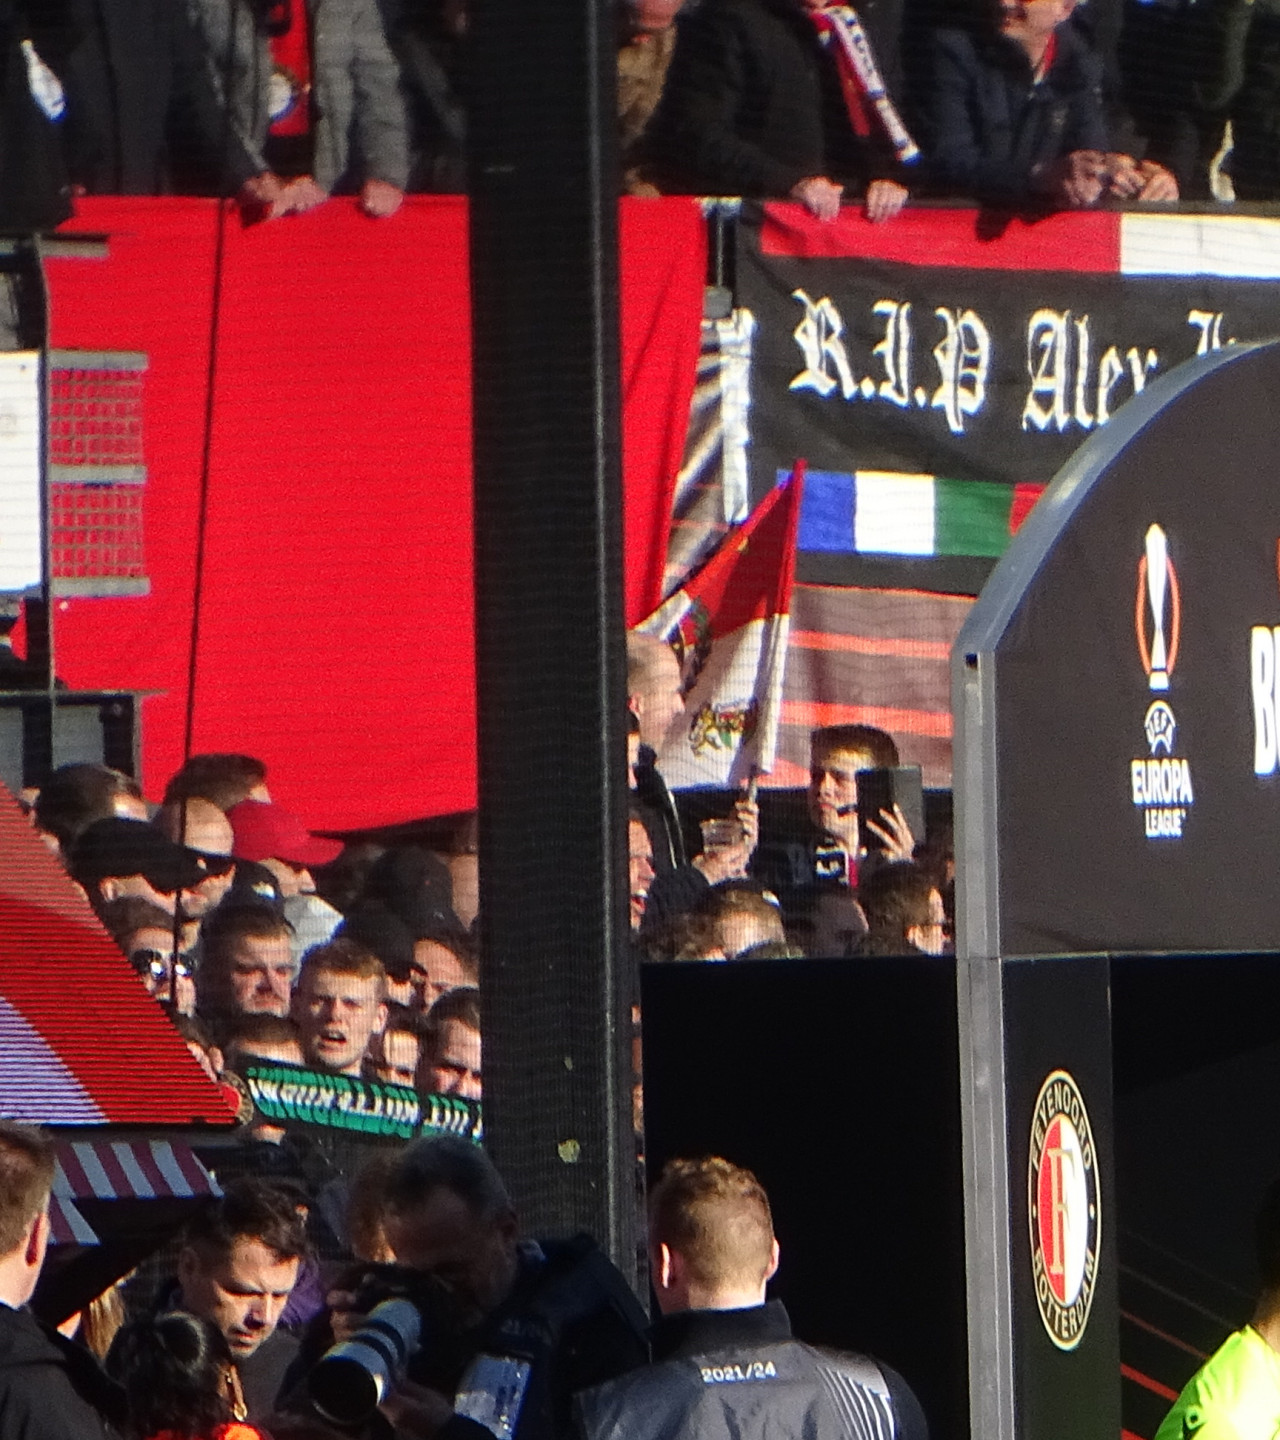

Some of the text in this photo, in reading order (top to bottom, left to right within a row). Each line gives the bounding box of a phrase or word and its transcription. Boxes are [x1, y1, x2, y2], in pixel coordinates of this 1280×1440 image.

[1131, 758, 1194, 805] EUROPA
[1145, 809, 1184, 838] LEAGUE
[700, 1361, 777, 1382] 2021/24
